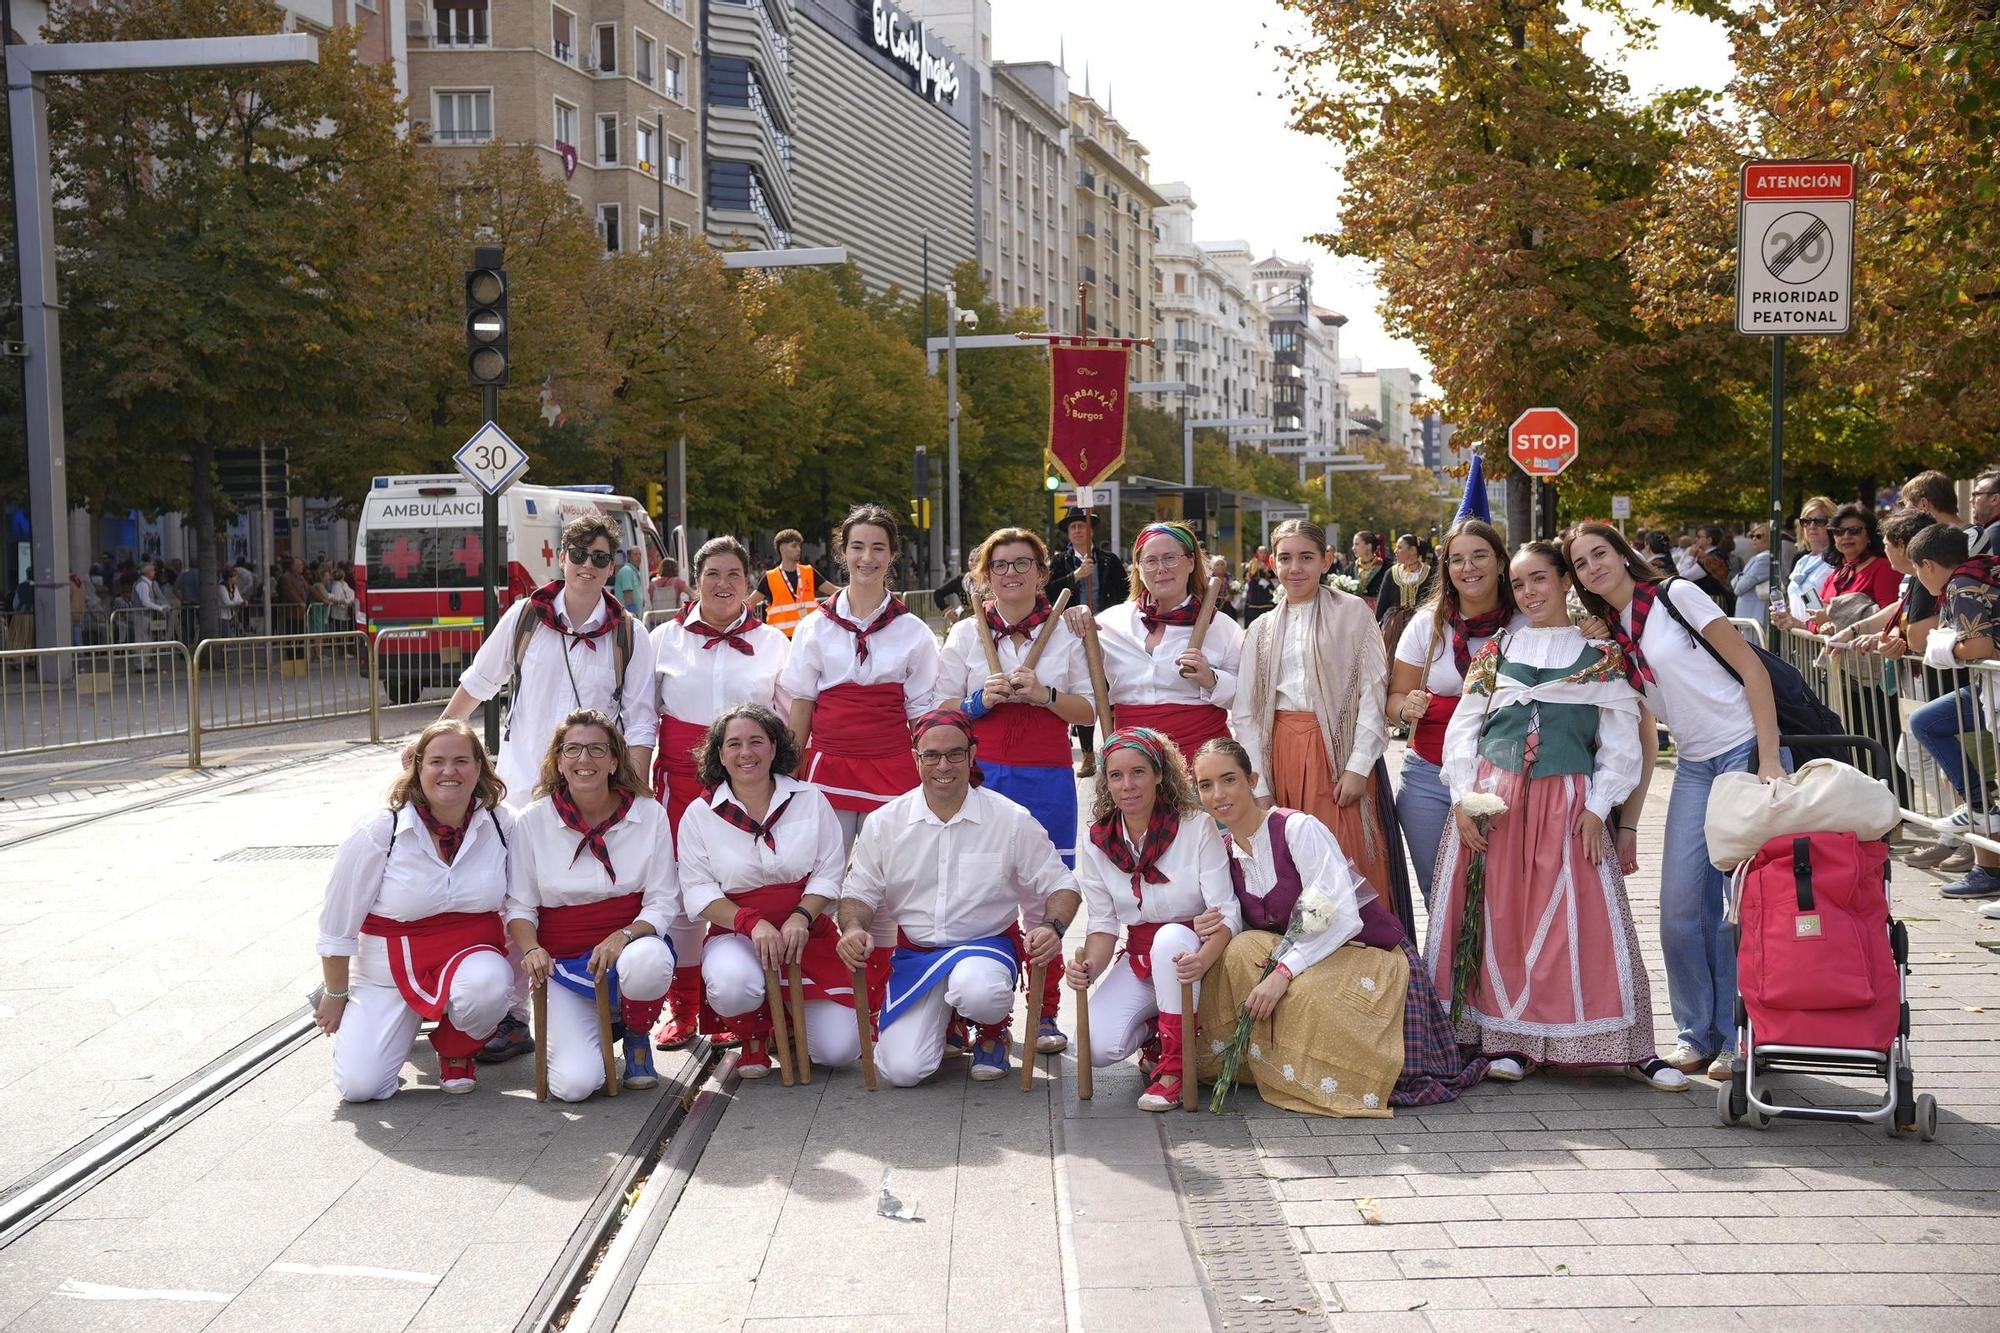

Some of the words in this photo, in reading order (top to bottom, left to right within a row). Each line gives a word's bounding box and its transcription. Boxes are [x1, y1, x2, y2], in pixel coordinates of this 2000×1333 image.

[873, 0, 888, 48] El
[889, 12, 920, 71] Corte
[920, 22, 960, 102] Inglés
[1757, 173, 1841, 188] ATENCIÓN
[1770, 232, 1825, 264] 20
[1753, 291, 1839, 304] PRIORIDAD
[1753, 311, 1838, 323] PEATONAL
[1072, 409, 1104, 422] Burgos
[1517, 434, 1571, 450] STOP
[475, 446, 507, 470] 30
[382, 502, 484, 518] AMBULANCI
